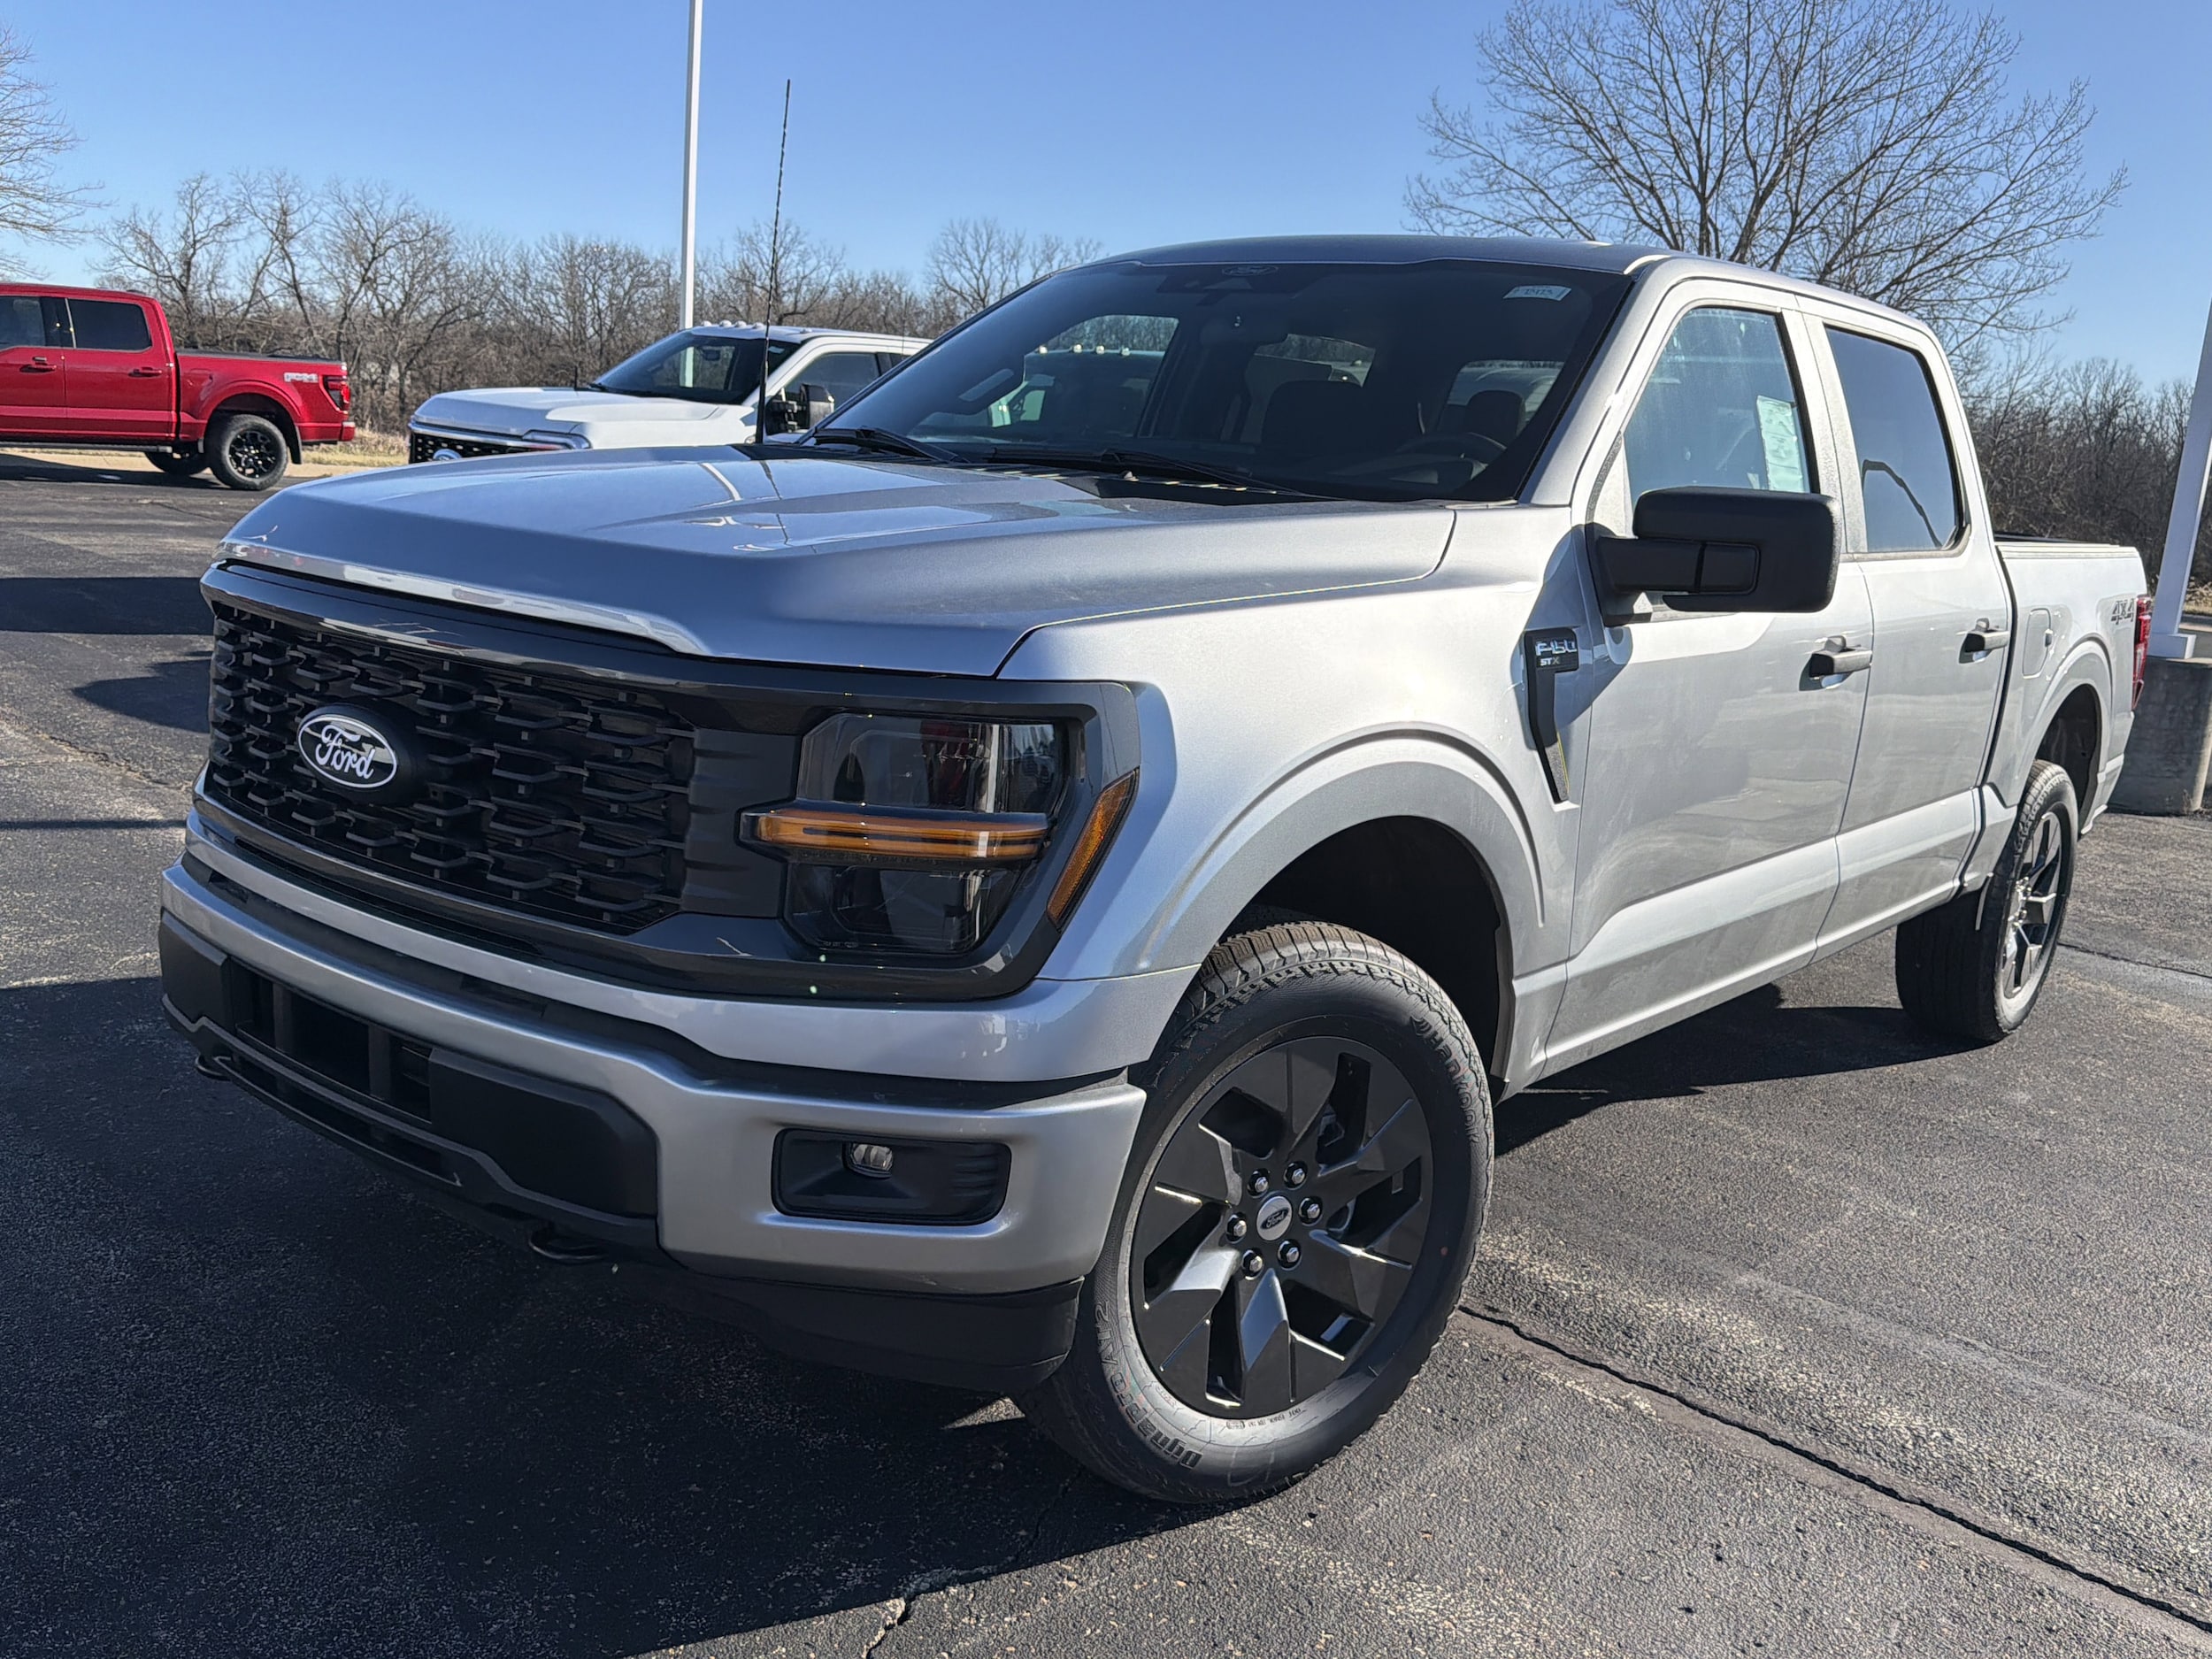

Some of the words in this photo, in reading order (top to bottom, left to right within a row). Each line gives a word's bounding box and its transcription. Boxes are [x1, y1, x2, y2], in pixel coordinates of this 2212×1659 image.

[1540, 657, 1560, 665] STX
[316, 725, 375, 779] Ford
[1094, 1300, 1118, 1366] AT2
